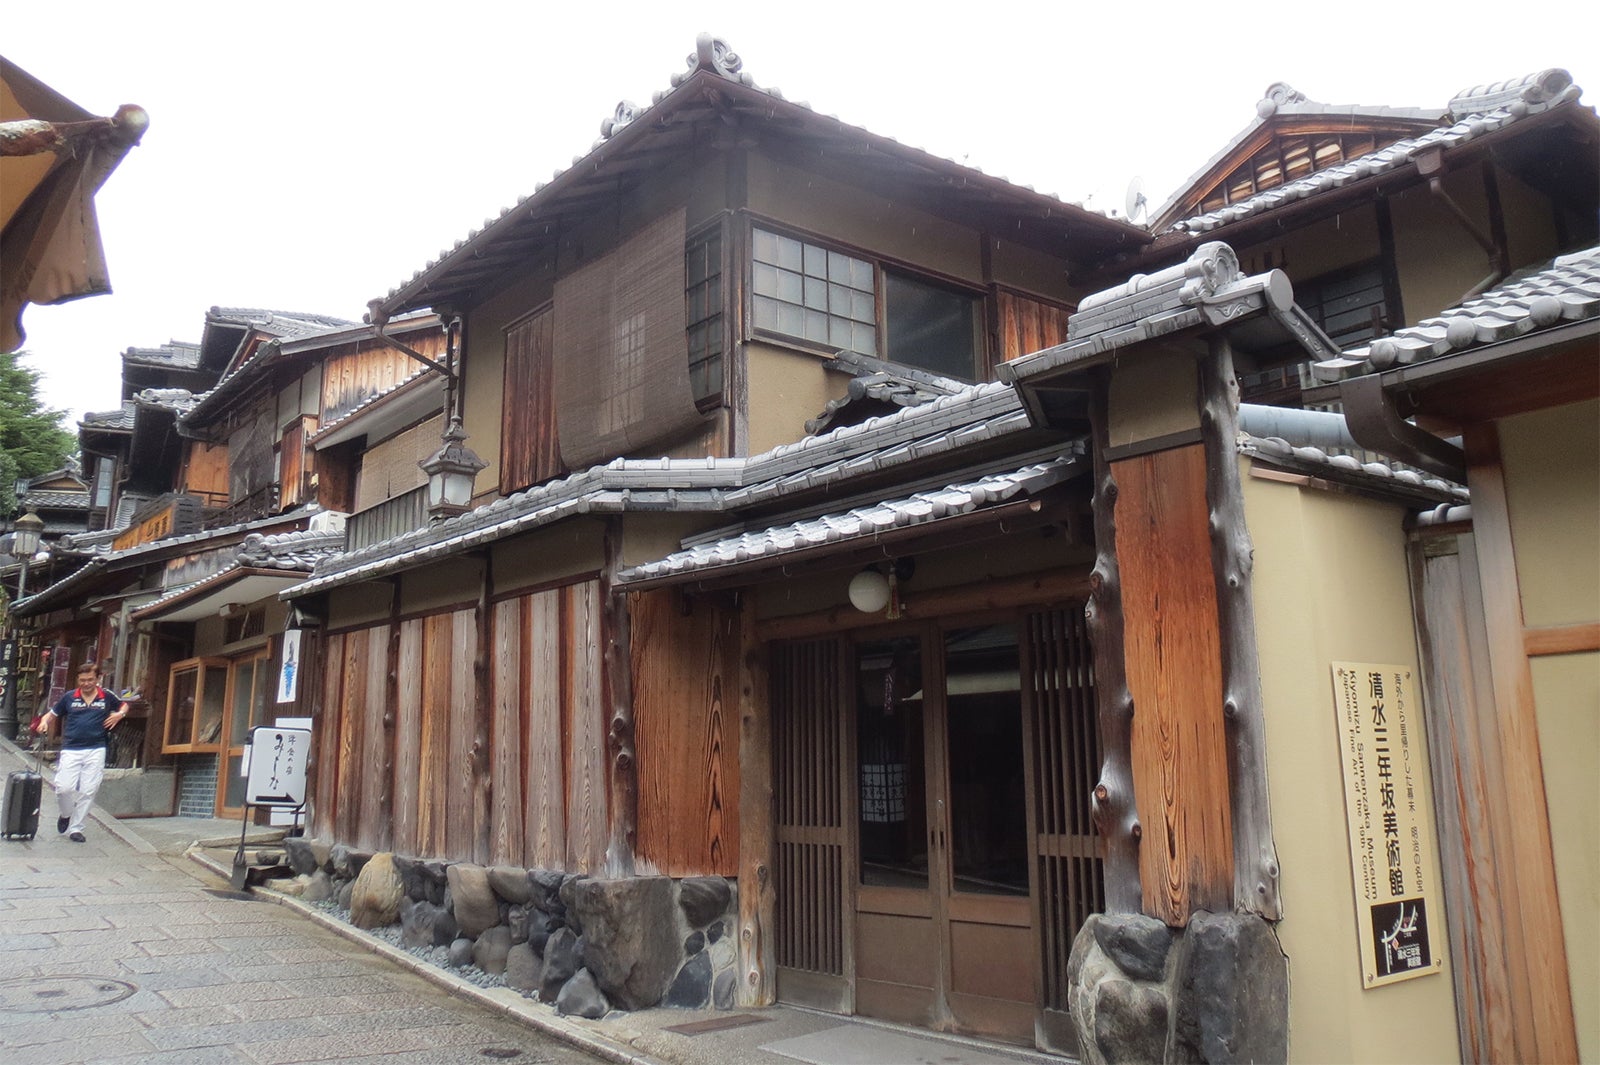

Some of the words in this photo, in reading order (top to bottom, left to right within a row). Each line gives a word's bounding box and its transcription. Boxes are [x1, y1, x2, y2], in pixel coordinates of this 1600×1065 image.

[1342, 671, 1352, 723] Japanese
[1362, 855, 1370, 900] Century
[1349, 670, 1360, 734] Kiyomizu
[1357, 743, 1370, 829] Sannenzaka
[1367, 838, 1377, 899] Museum
[1369, 673, 1403, 895] 清水三年坂美術館
